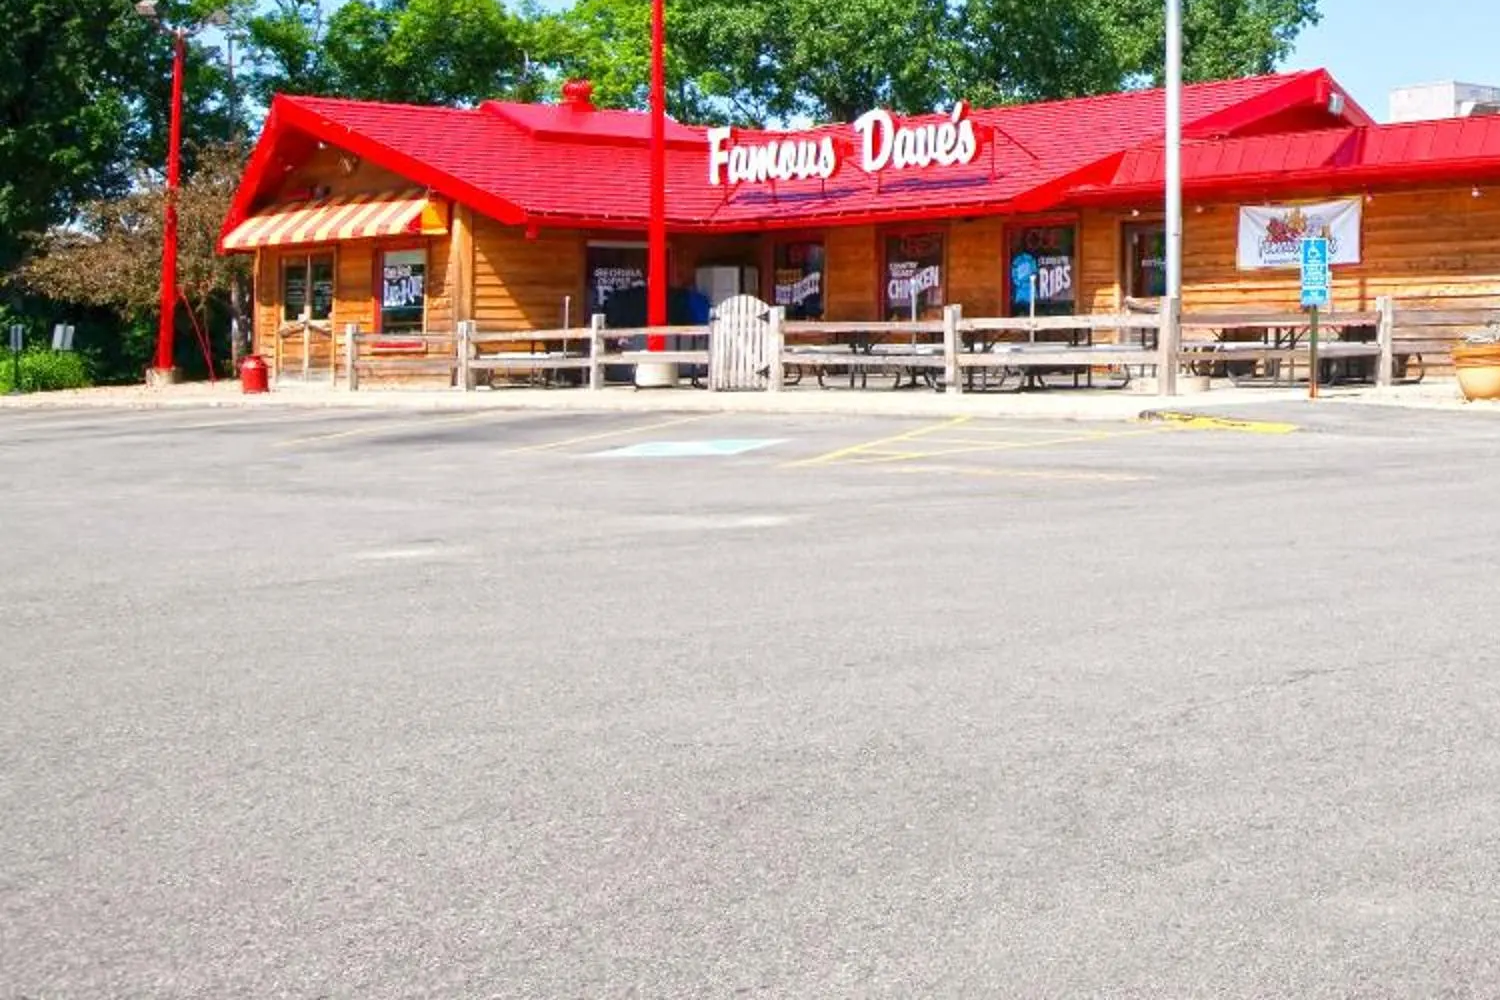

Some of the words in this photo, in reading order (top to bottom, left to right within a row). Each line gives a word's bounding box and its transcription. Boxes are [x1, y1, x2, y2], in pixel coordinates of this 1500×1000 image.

[707, 126, 836, 185] Famous
[854, 100, 976, 173] Dave's
[1039, 265, 1072, 300] RIBS
